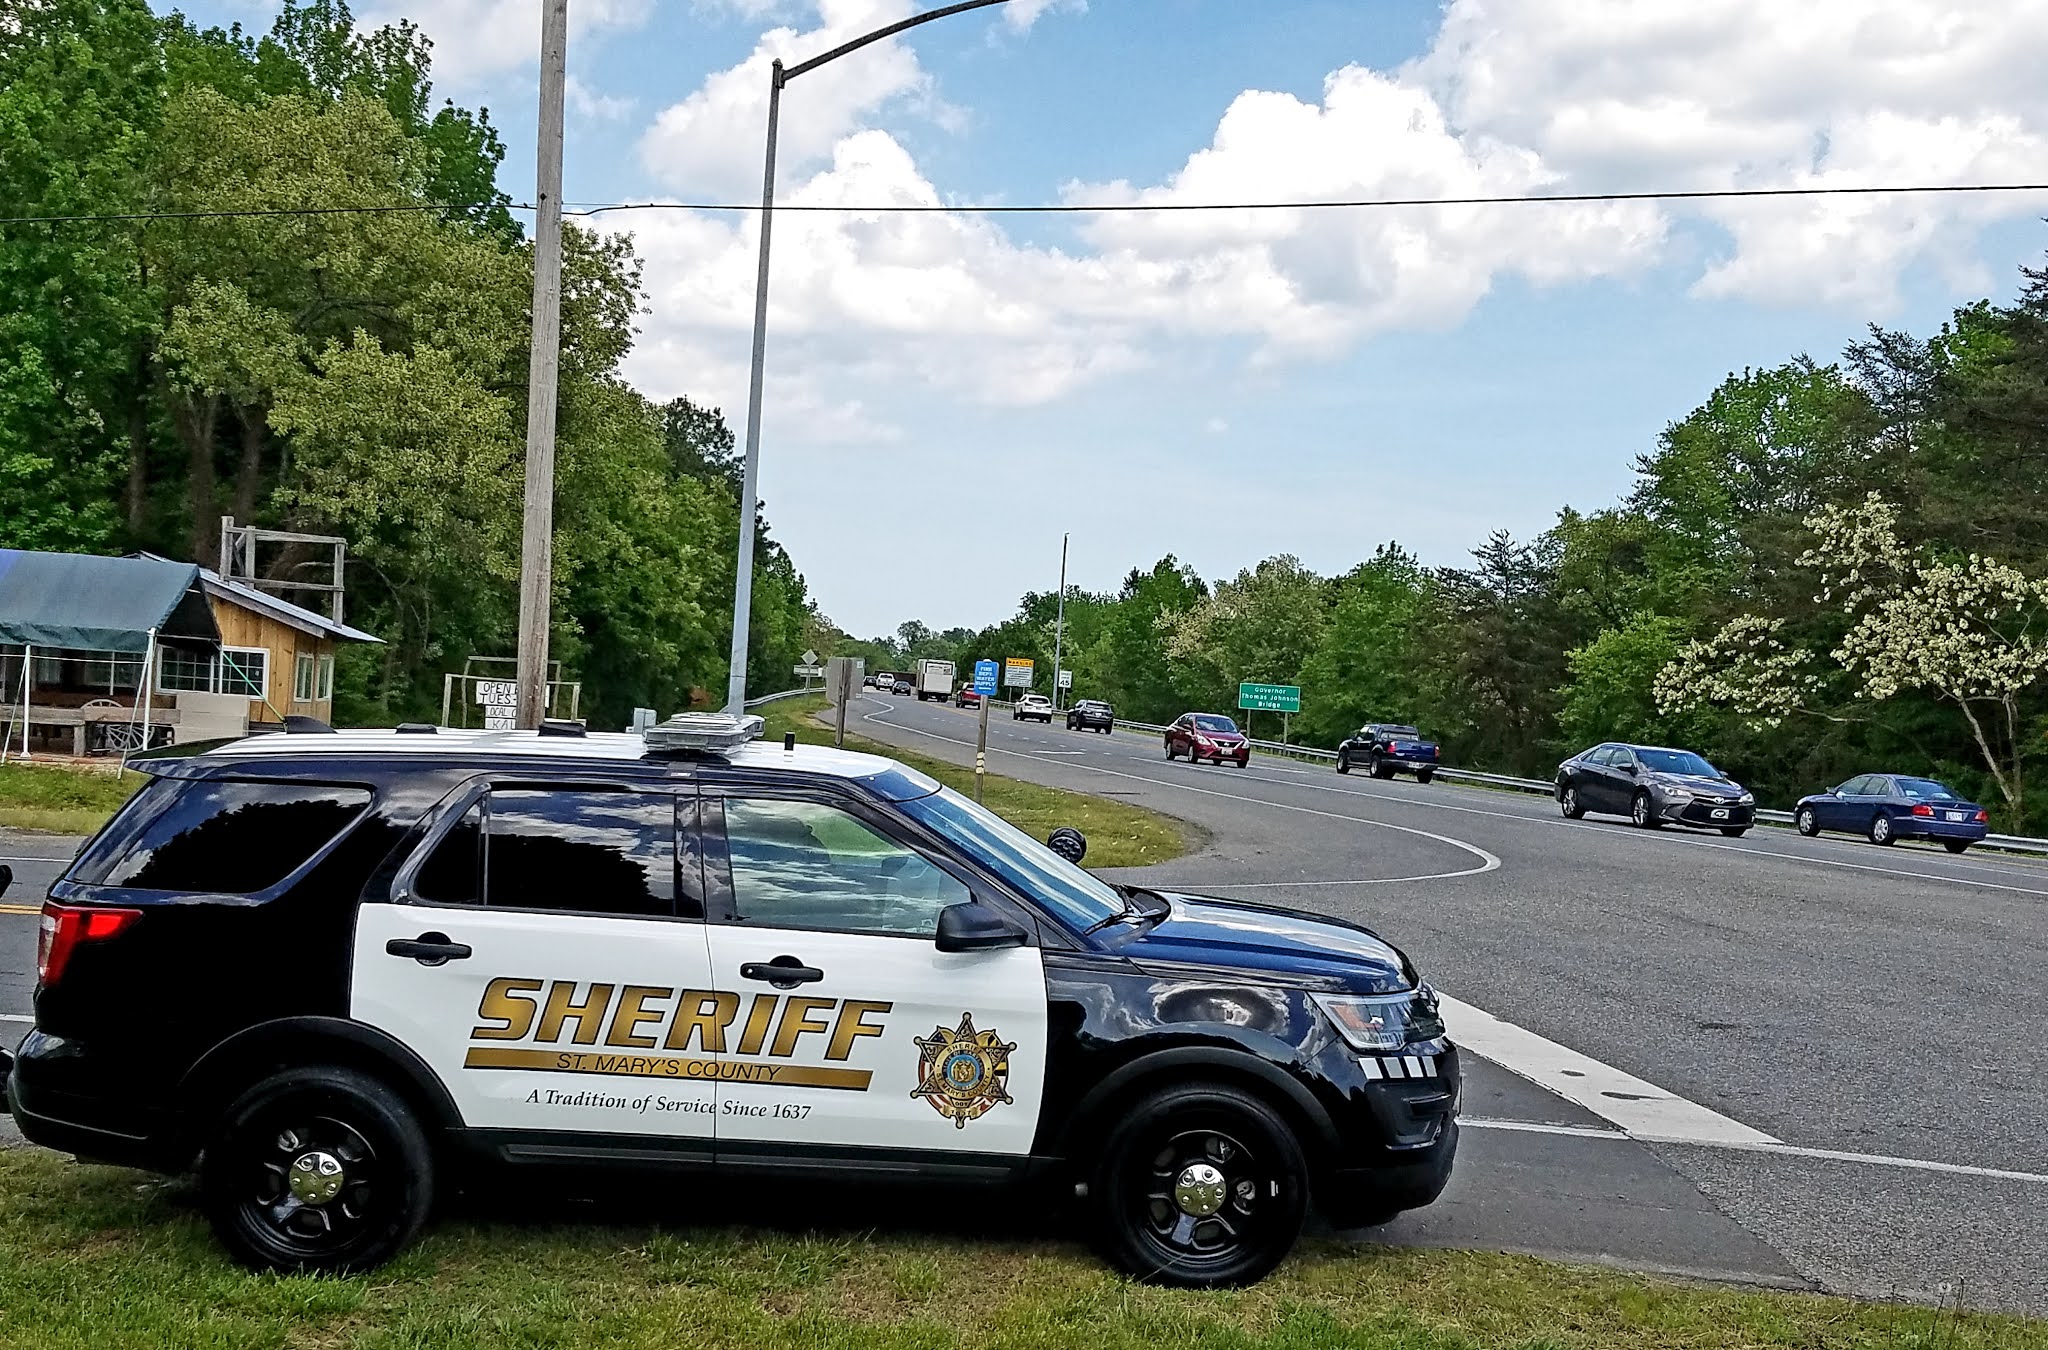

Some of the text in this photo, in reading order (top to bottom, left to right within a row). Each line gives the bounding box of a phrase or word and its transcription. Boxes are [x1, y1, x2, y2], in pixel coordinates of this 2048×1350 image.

[483, 682, 512, 694] OPEN
[469, 976, 894, 1061] SHERIFF
[946, 1043, 983, 1054] SHERIFF
[556, 1053, 782, 1081] ST. MARY'S COUNTY
[967, 1074, 990, 1097] COUNTY
[525, 1088, 812, 1120] A Tradition of Service Since 1637
